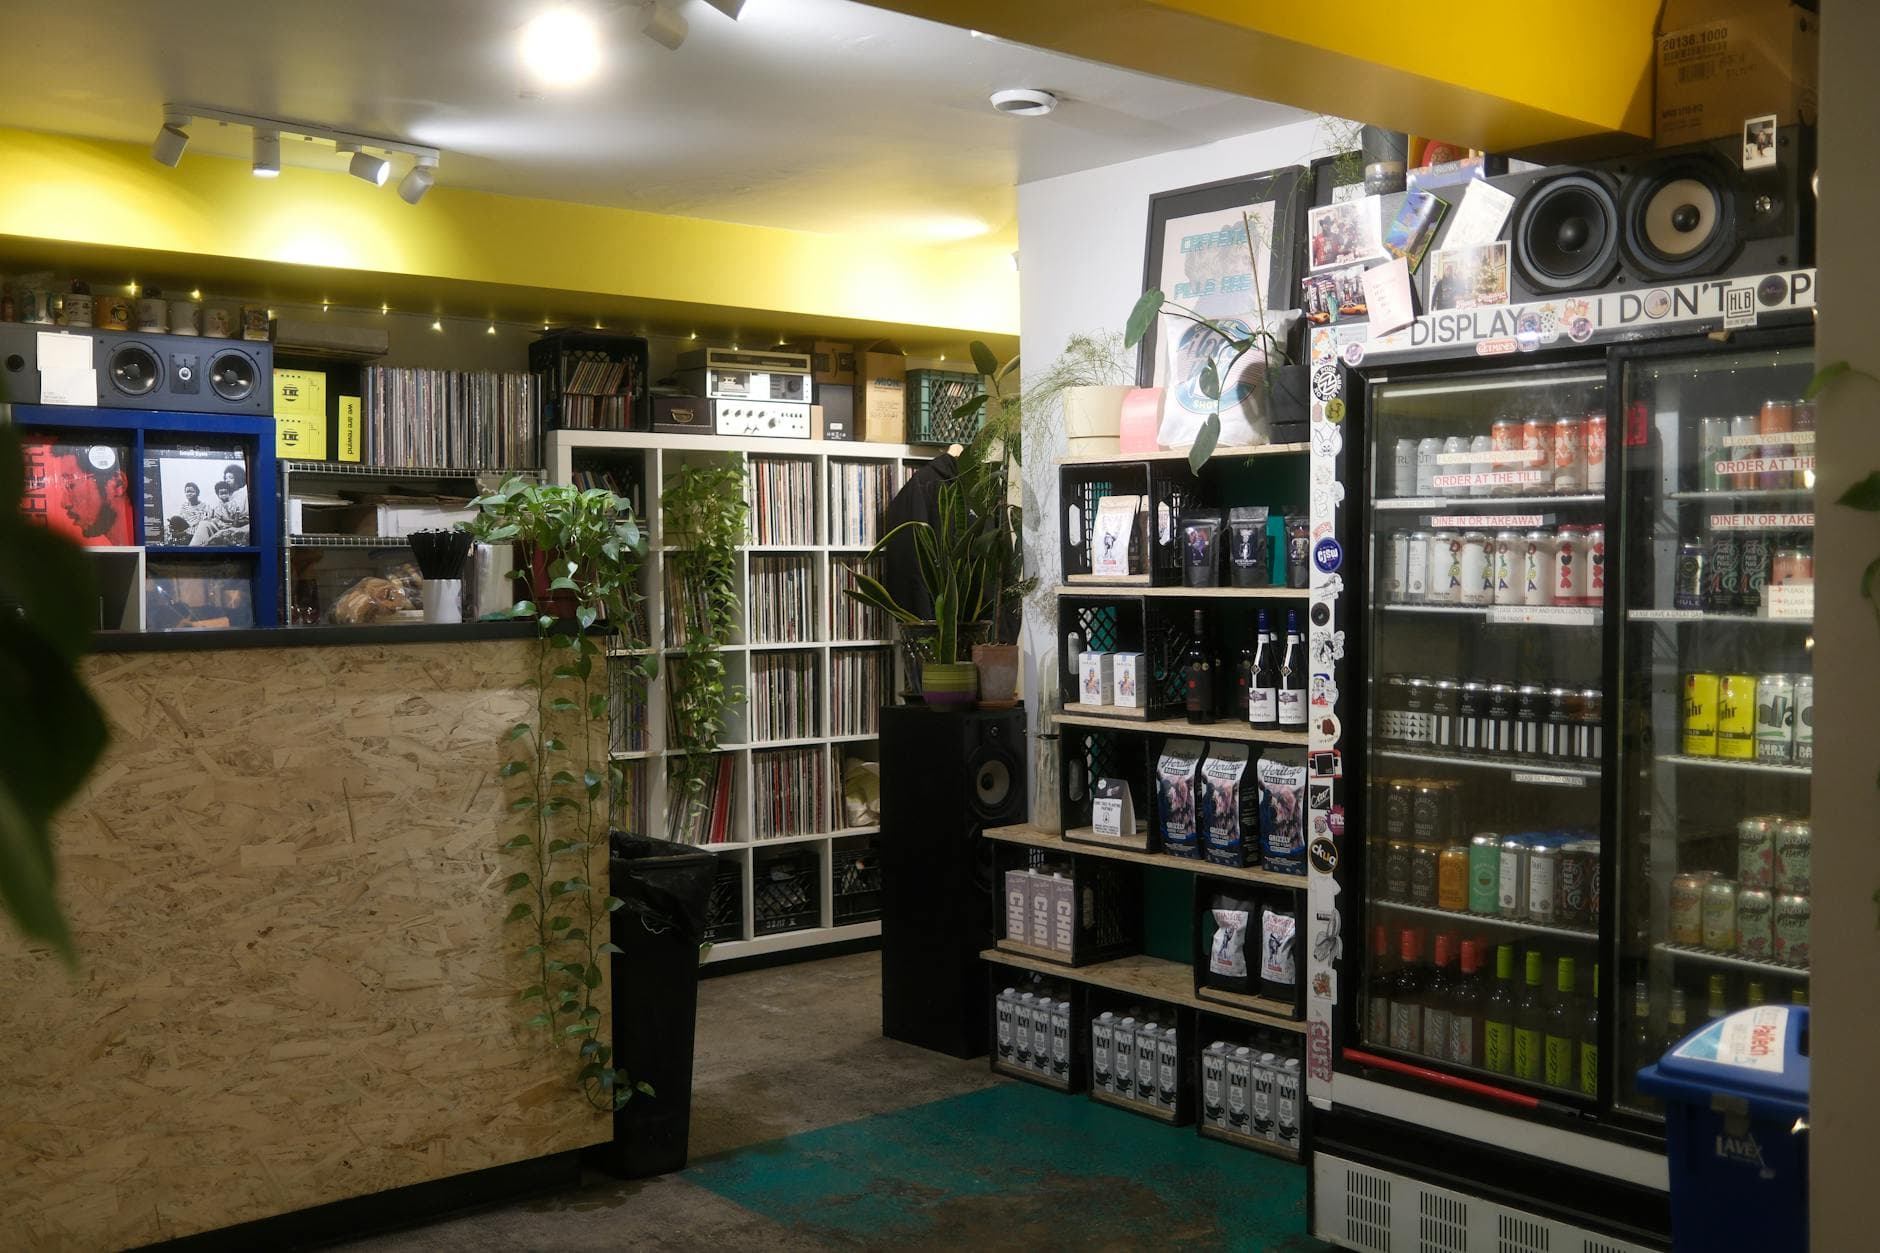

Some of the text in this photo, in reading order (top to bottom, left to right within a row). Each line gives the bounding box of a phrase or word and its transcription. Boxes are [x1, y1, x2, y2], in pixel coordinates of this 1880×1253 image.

[1663, 28, 1728, 51] 20138.1000
[1730, 291, 1752, 313] HLB
[1411, 307, 1525, 346] DISPLAY
[1597, 297, 1603, 327] I
[1620, 280, 1733, 324] DN'T
[347, 403, 353, 413] we
[1716, 460, 1764, 473] ORDER
[1768, 459, 1786, 471] AT
[1434, 471, 1540, 486] ORDER AT THE TILL
[1432, 515, 1543, 527] DINE IN OR TAKEAWAY
[1711, 515, 1738, 526] DINE
[1743, 515, 1755, 525] IN
[1758, 515, 1777, 525] OR
[1206, 759, 1245, 774] Heritage
[1261, 763, 1303, 778] Heritage
[1009, 891, 1024, 940] CHAI
[1034, 896, 1048, 946] CHAI
[1057, 900, 1072, 952] CHAI
[1000, 1011, 1012, 1023] LY!
[1018, 1016, 1029, 1028] LY!
[1035, 1021, 1047, 1033] LY!
[1055, 1026, 1067, 1038] LY!
[1097, 1036, 1110, 1049] LY!
[1118, 1042, 1131, 1055] LY!
[1140, 1048, 1154, 1060] LY!
[1161, 1054, 1176, 1067] LY!
[1207, 1068, 1222, 1081] LY!
[1231, 1074, 1247, 1087] LY!
[1256, 1080, 1272, 1094] LY!
[1280, 1086, 1296, 1101] LY!
